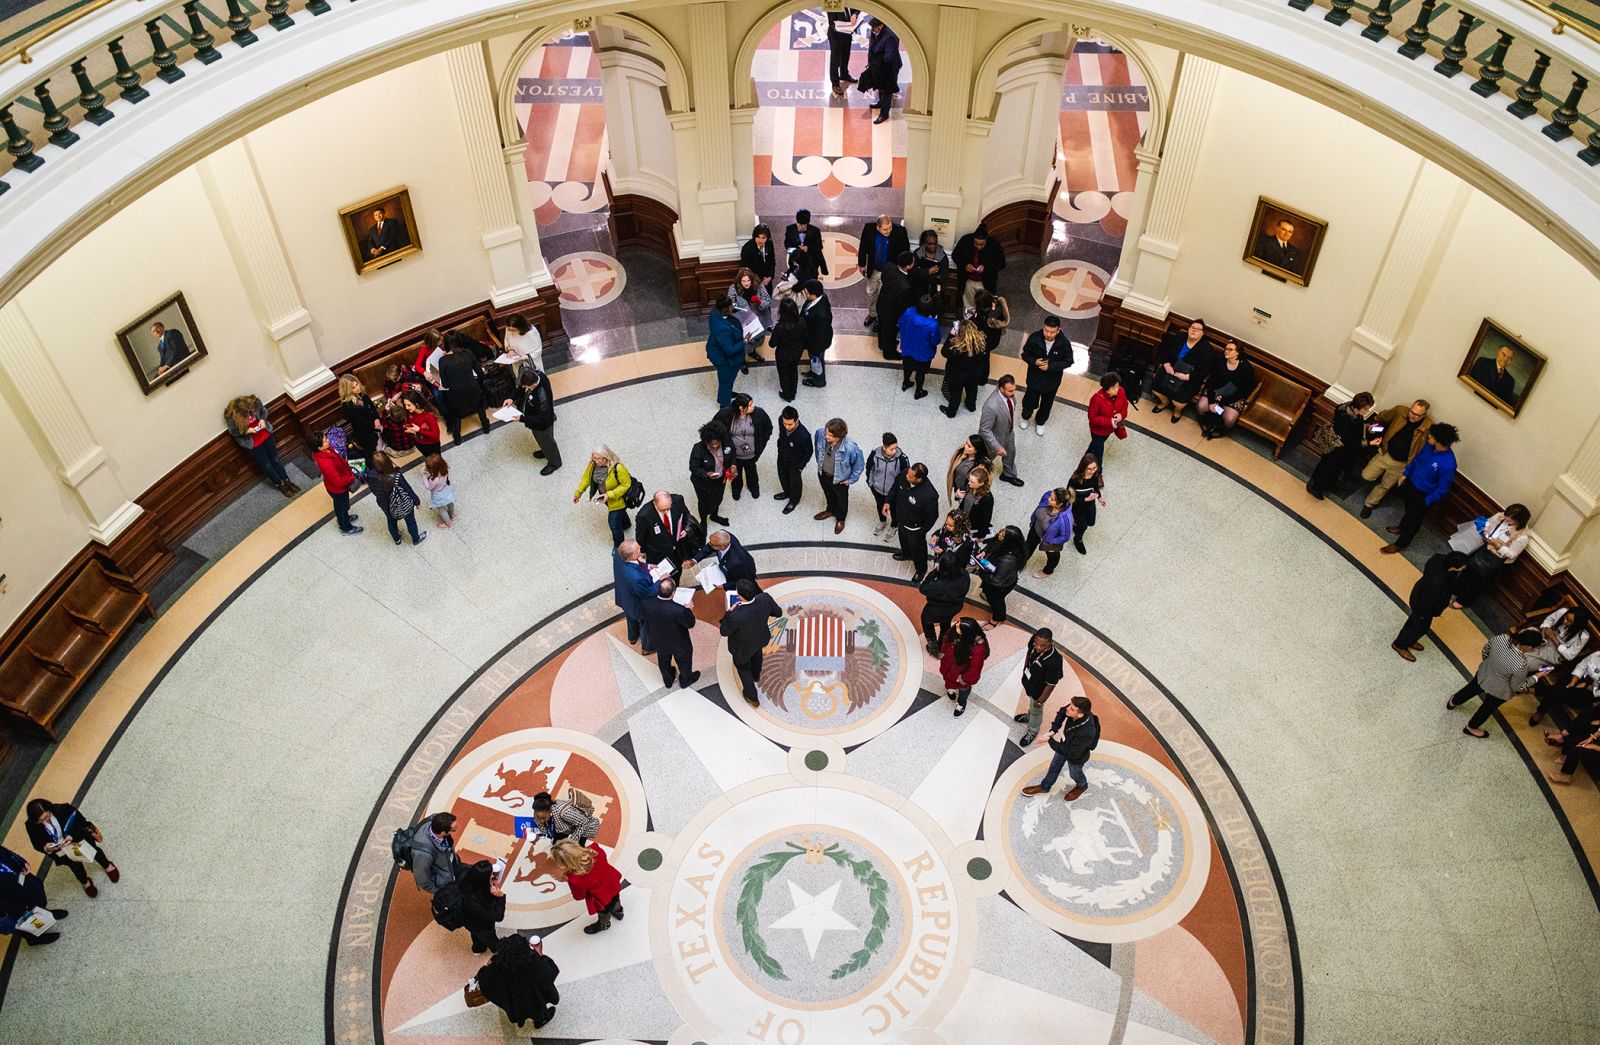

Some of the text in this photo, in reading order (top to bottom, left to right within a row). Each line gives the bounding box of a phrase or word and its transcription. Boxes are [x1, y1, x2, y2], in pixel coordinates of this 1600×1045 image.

[862, 88, 903, 100] SN
[1061, 92, 1149, 104] ABINE P
[476, 659, 524, 700] THE
[387, 704, 476, 814] KINGDOM
[1172, 728, 1233, 804] STATES
[345, 871, 386, 950] SPAIN
[1220, 808, 1287, 988] CONFEDERATE
[676, 842, 952, 1045] REPUBLIC OF TEXAS
[1261, 994, 1290, 1045] HE
